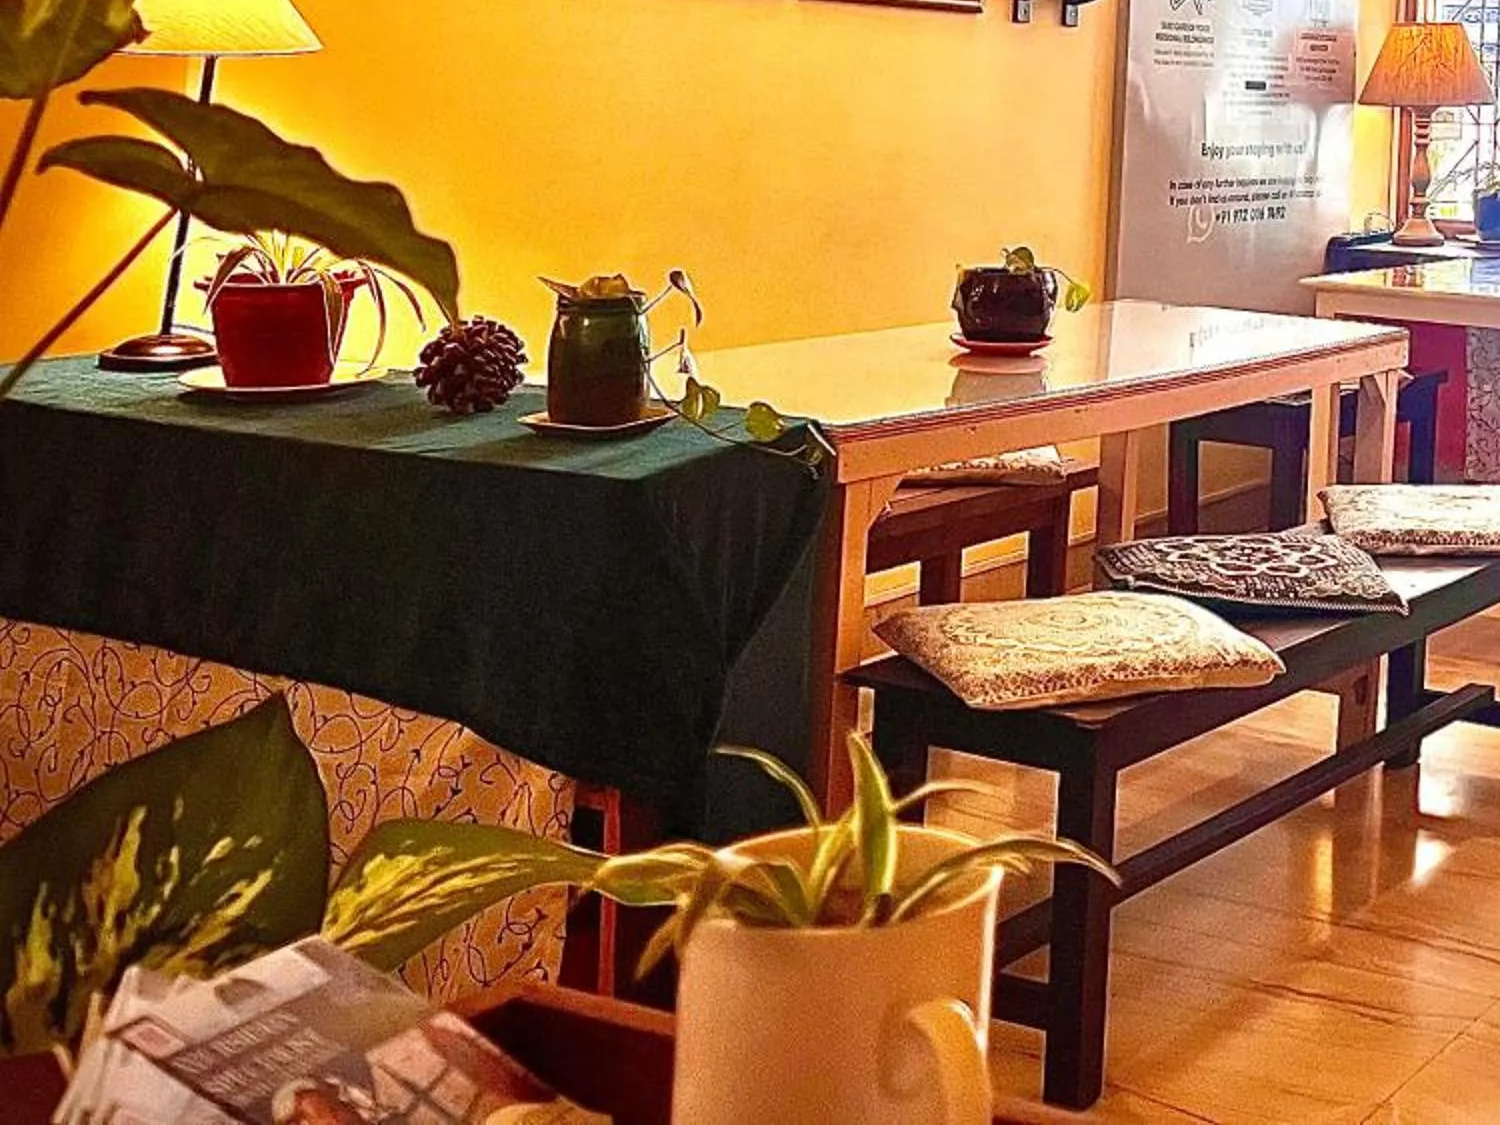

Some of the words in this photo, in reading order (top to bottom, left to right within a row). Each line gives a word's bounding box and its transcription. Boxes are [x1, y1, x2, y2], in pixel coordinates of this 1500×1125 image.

[1201, 142, 1224, 162] Enjoy
[1225, 144, 1244, 161] your
[1215, 209, 1231, 224] +91
